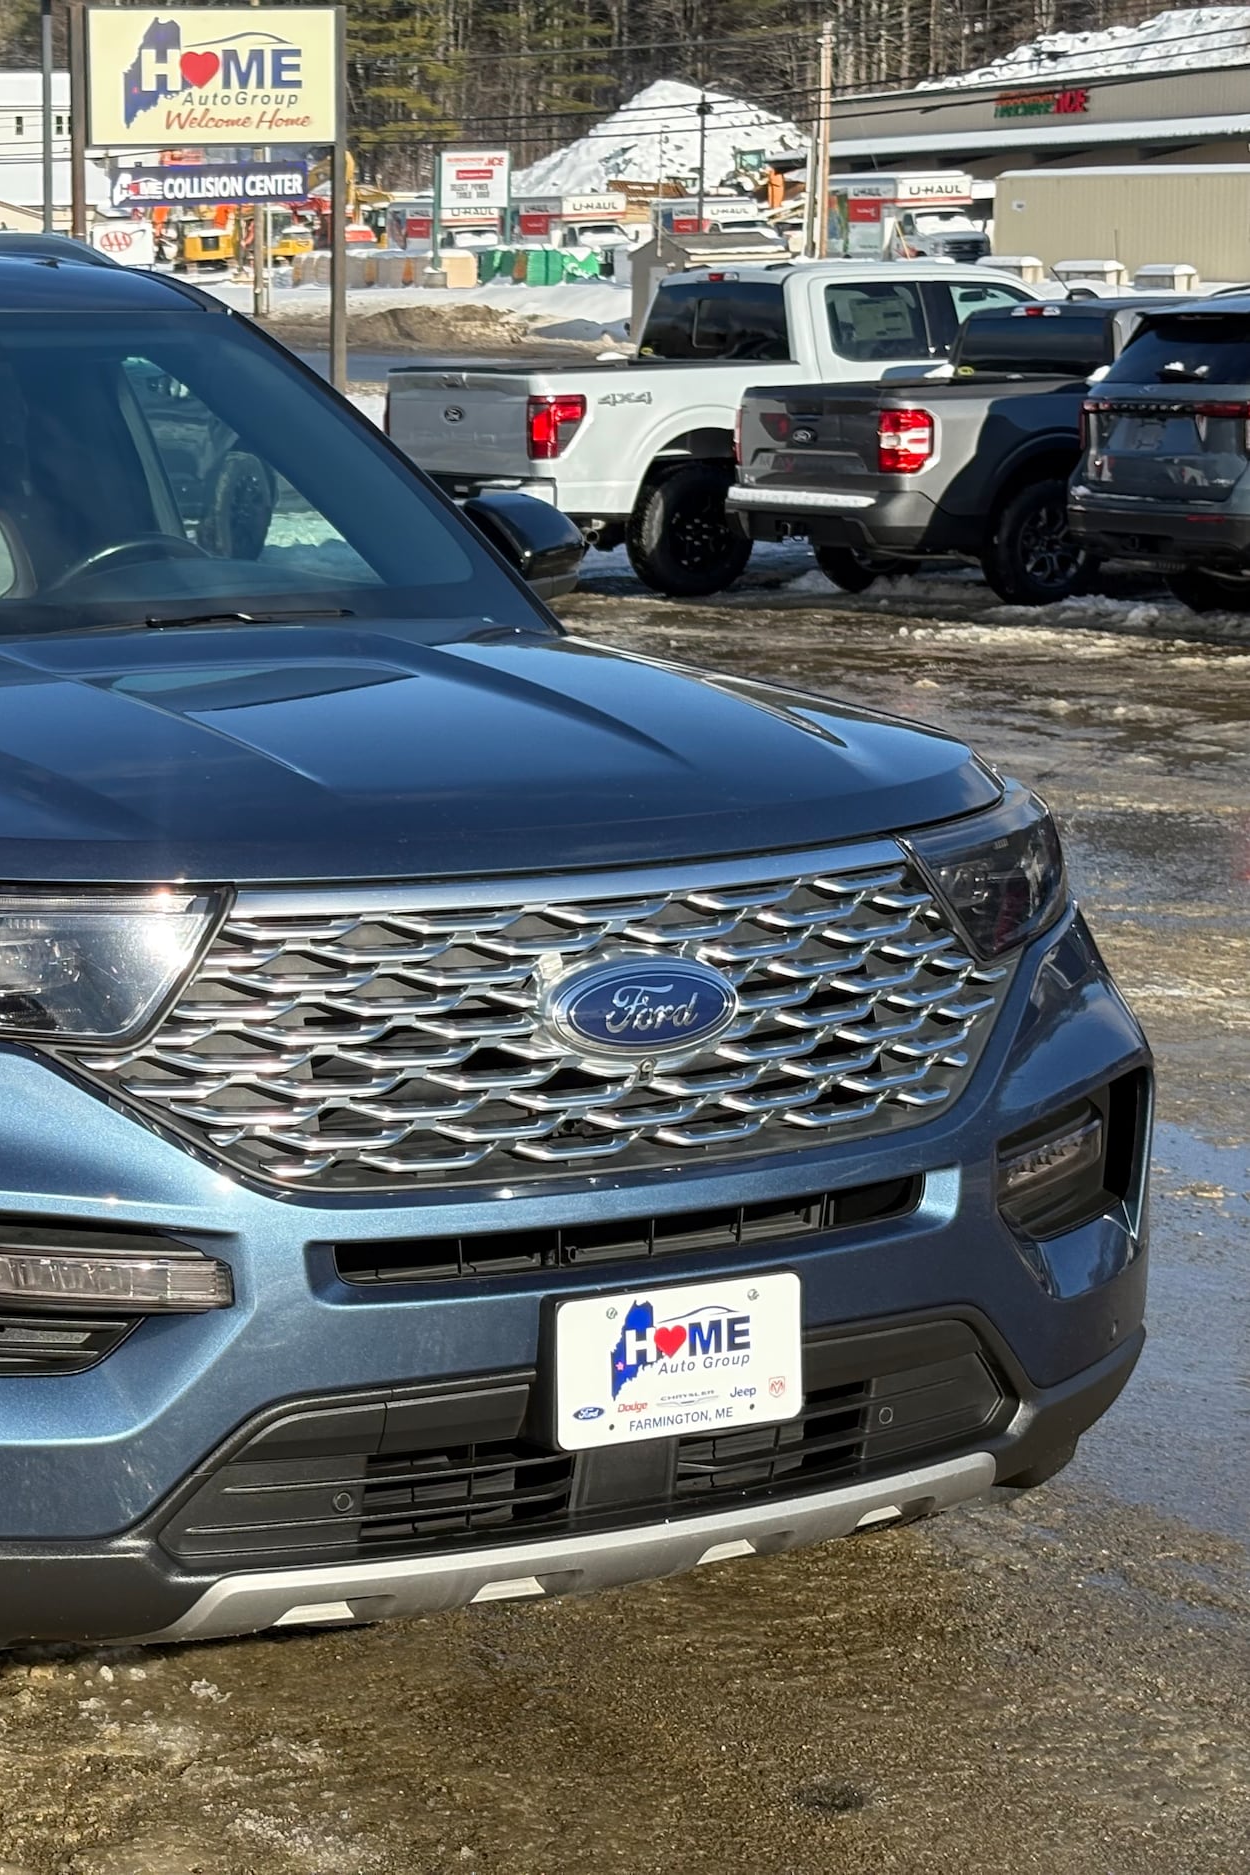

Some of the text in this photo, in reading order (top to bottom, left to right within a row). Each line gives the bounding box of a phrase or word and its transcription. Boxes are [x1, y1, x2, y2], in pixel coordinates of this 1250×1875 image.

[165, 108, 311, 130] Welcome Home
[164, 176, 244, 199] COLLISION
[245, 173, 304, 197] CENTER
[909, 185, 963, 196] U-HAUL
[572, 201, 618, 211] U-HAUL
[605, 983, 699, 1034] Ford
[658, 1353, 751, 1376] Auto Group
[617, 1401, 648, 1414] Dodge
[659, 1389, 716, 1402] CHRYSLER
[729, 1386, 757, 1400] Jeep
[629, 1406, 734, 1432] FARMINGTON, ME
